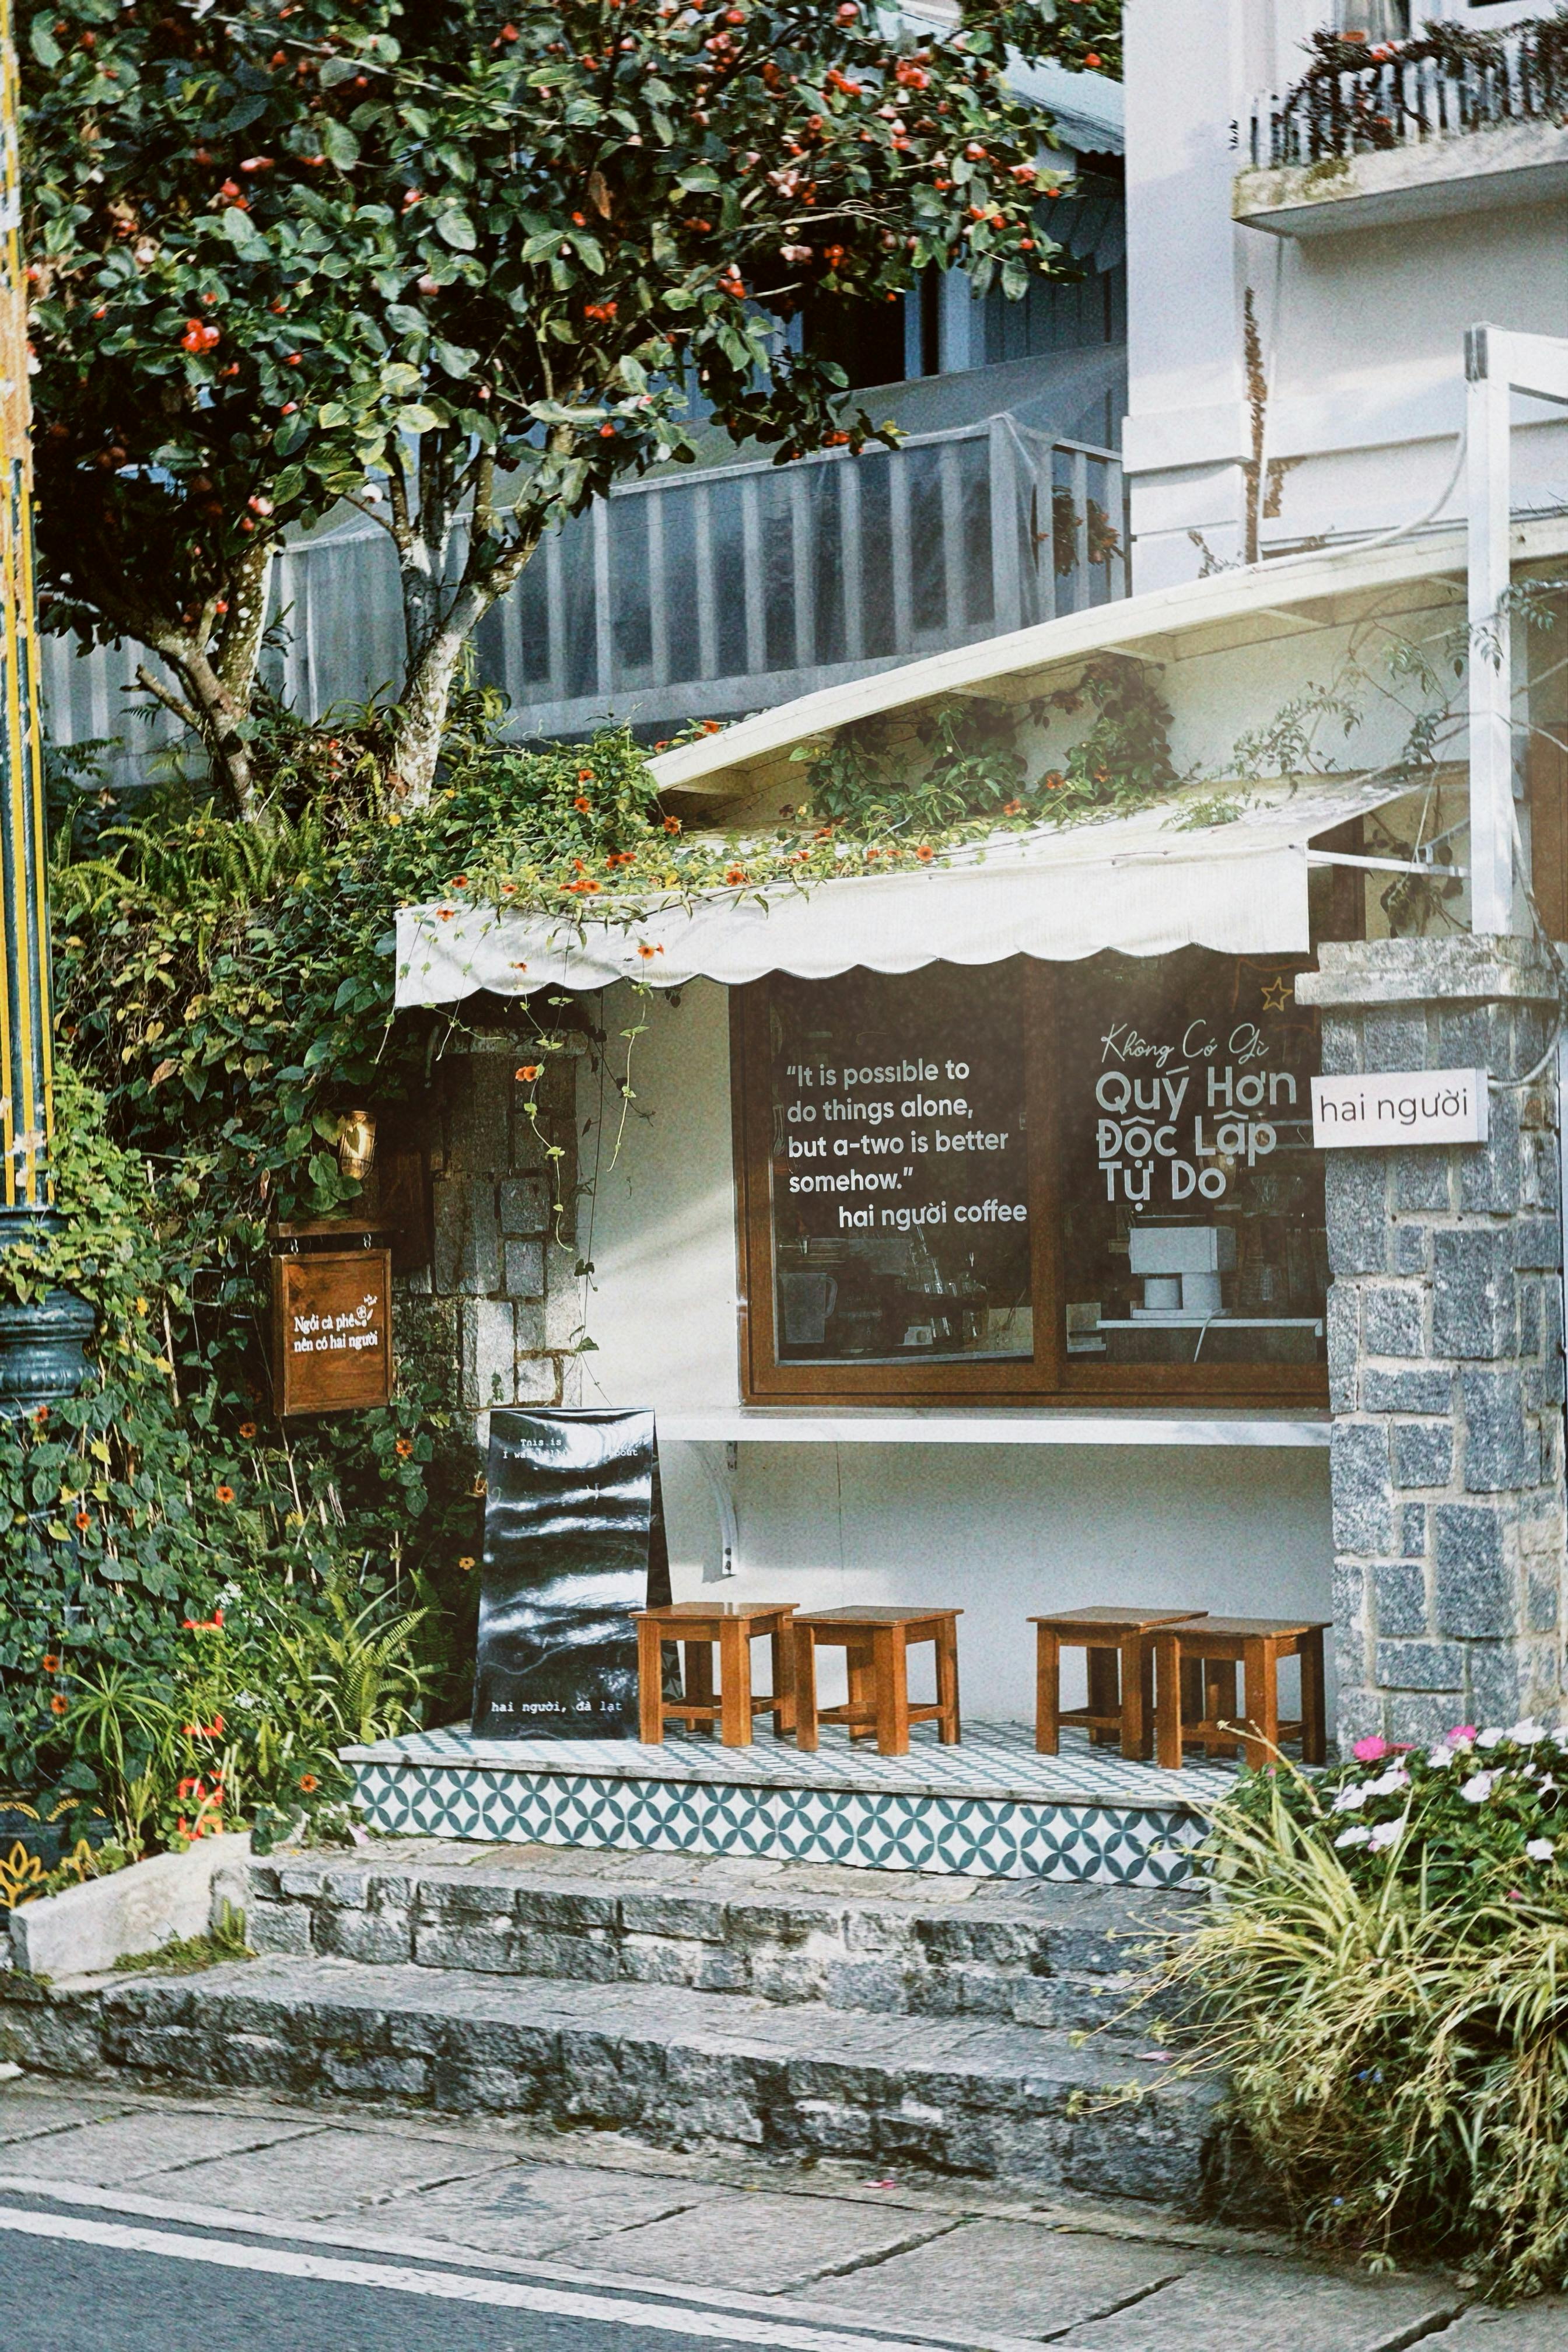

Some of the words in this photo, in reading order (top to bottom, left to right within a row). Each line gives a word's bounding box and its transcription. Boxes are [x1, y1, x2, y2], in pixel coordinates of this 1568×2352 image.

[1101, 1023, 1174, 1068] Không
[1183, 1020, 1217, 1058] Có
[1229, 1023, 1269, 1065] Gì
[820, 1064, 836, 1086] is
[844, 1058, 939, 1090] possible
[945, 1059, 970, 1080] to
[1096, 1065, 1189, 1121] Quý
[1208, 1066, 1296, 1107] Hơn
[1320, 1093, 1365, 1122] hai
[1378, 1088, 1467, 1125] người
[788, 1100, 816, 1122] do
[823, 1098, 894, 1125] things
[901, 1094, 973, 1119] alone,
[789, 1136, 827, 1157] but
[834, 1135, 904, 1156] a-two
[911, 1130, 929, 1153] is
[936, 1130, 1008, 1152] better
[1096, 1115, 1178, 1168] Độc
[1195, 1110, 1276, 1167] Lập
[1099, 1160, 1154, 1212] Tự
[1172, 1160, 1226, 1200] Do
[839, 1204, 874, 1228] hai
[881, 1200, 947, 1231] người
[954, 1199, 1027, 1223] coffee
[321, 1314, 334, 1330] cà
[336, 1312, 355, 1332] phê
[294, 1337, 314, 1353] nên
[316, 1335, 328, 1350] có
[330, 1332, 346, 1349] hai
[348, 1330, 378, 1350] người
[520, 1438, 544, 1447] This
[551, 1437, 562, 1446] is
[491, 1701, 514, 1712] hai
[600, 1701, 623, 1713] lạt
